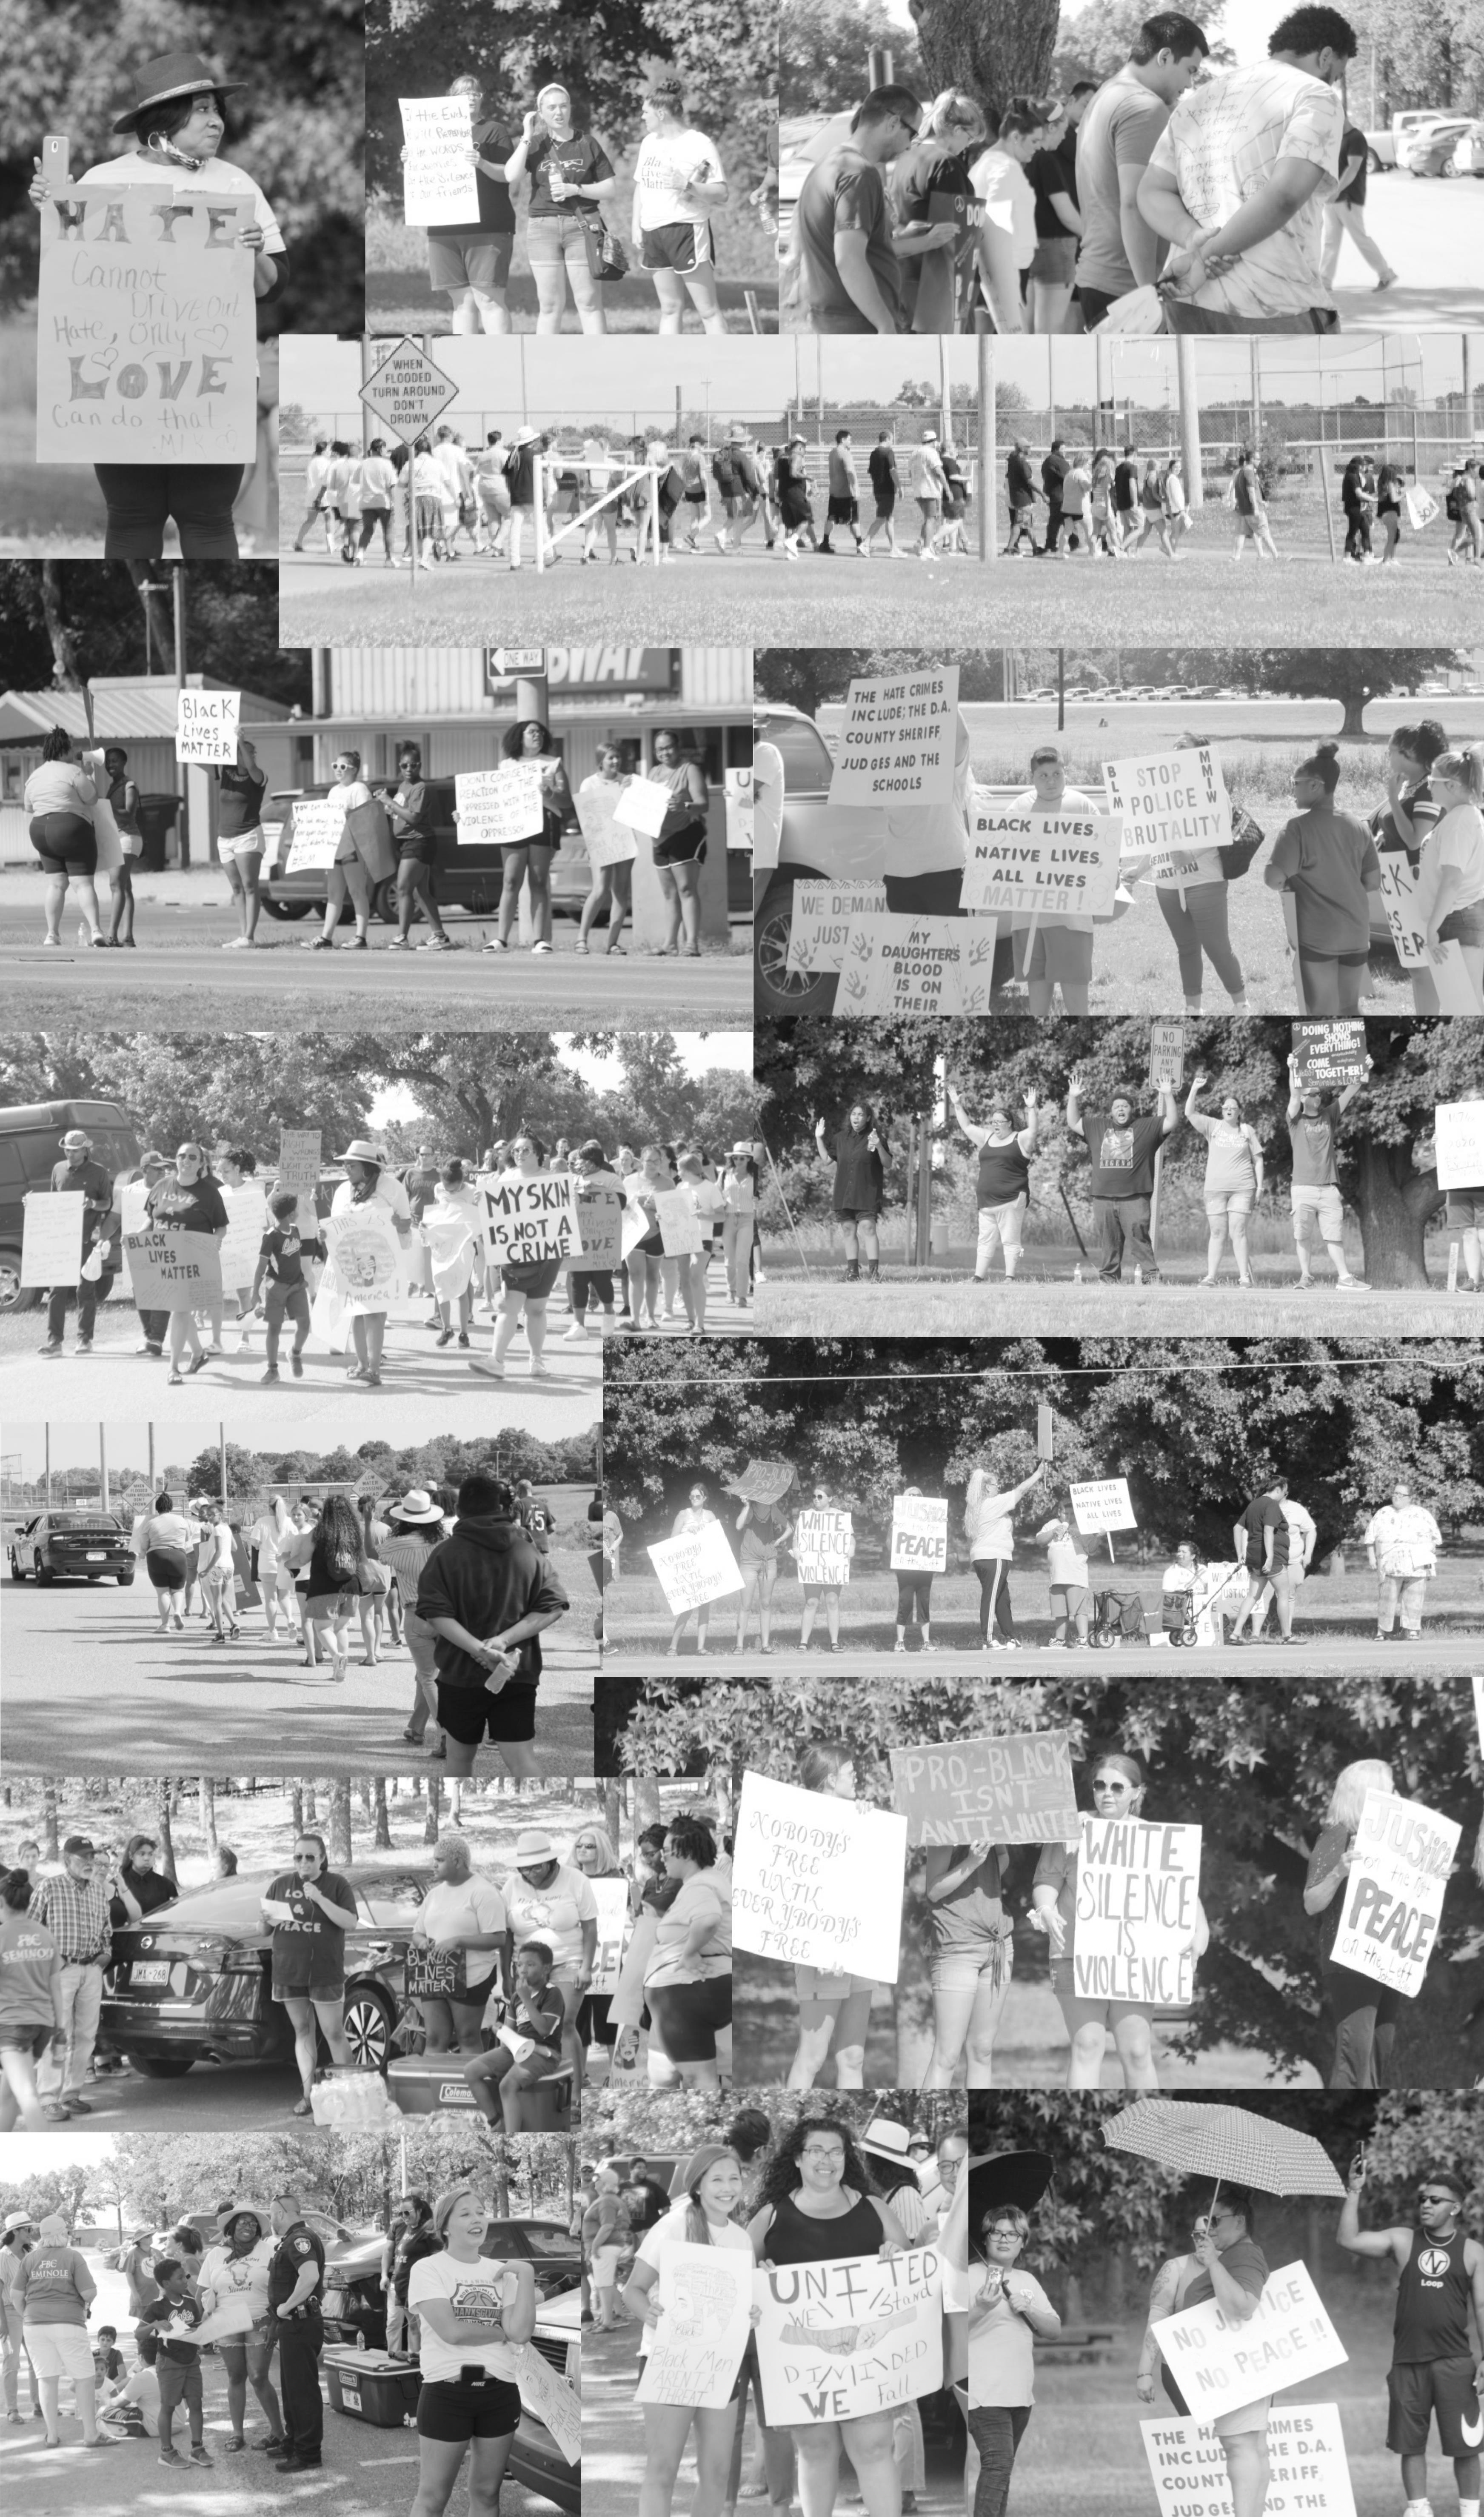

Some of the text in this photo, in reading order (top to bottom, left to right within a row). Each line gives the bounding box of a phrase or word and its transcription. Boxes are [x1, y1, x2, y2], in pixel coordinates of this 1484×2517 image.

[416, 109, 439, 122] the
[429, 143, 465, 155] WORDS
[53, 200, 237, 250] HATE
[72, 250, 167, 292] Cannot
[131, 291, 241, 322] Drive Out
[54, 315, 186, 362] Hate, Only
[393, 359, 422, 369] WHEN
[68, 353, 234, 402] LOVE
[385, 372, 431, 383] FLOODED
[372, 385, 445, 397] TURN AROUND
[393, 399, 423, 410] DON'T
[52, 404, 143, 428] Can do
[390, 414, 428, 424] DROWN
[504, 651, 539, 666] ONE WAY
[855, 681, 943, 703] THE HATE CRIMES
[851, 700, 951, 722] INCLUDE; THE D.A.
[846, 725, 942, 744] COUNTY SHERIFF,
[181, 741, 231, 758] MATTER
[842, 753, 939, 770] JUDGES AND THE
[490, 763, 537, 783] CONFUSE THE
[1136, 763, 1181, 787] STOP
[459, 776, 534, 800] REACTION OF THE
[872, 777, 922, 792] SCHOOLS
[503, 790, 537, 807] WITH THE
[1131, 788, 1197, 816] POLICE
[461, 802, 538, 826] VIOLENCE OF THE
[481, 825, 524, 838] OPPRESSOR
[977, 818, 1099, 841] BLACK LIVES,
[1124, 813, 1220, 847] BRUTALITY
[975, 846, 1103, 868] NATIVE LIVES,
[992, 869, 1086, 888] ALL LIVES
[802, 896, 824, 915] WE
[909, 931, 931, 944] MY
[893, 962, 942, 976] BLOOD
[896, 979, 942, 994] IS ON
[893, 996, 938, 1012] THEIR
[1163, 1032, 1174, 1043] NO
[1302, 1021, 1365, 1036] DOING NOTHING
[1324, 1032, 1350, 1043] SHOWS
[1154, 1045, 1181, 1058] PARKING
[1310, 1037, 1361, 1055] EVERYTHING!
[1161, 1058, 1173, 1067] ANY
[1307, 1058, 1330, 1069] COME
[1315, 1064, 1363, 1079] TOGETHER!
[1159, 1067, 1174, 1077] TIME
[1343, 1075, 1360, 1085] LOVE
[283, 1139, 305, 1149] RIGHT
[282, 1161, 301, 1170] LIGHT
[285, 1170, 317, 1181] TRUTH
[162, 1192, 195, 1204] LOVE
[484, 1179, 570, 1218] MY SKIN
[489, 1215, 572, 1245] IS NOT A
[128, 1235, 166, 1249] BLACK
[506, 1239, 571, 1263] CRIME
[148, 1250, 176, 1263] LIVES
[161, 1264, 200, 1279] MATTER
[1073, 1486, 1094, 1495] BLACK
[1076, 1500, 1101, 1508] NATIVE
[528, 1510, 545, 1531] 45
[802, 1512, 845, 1532] WHITE
[799, 1532, 849, 1554] SILENCE
[896, 1532, 945, 1558] PEACE
[674, 1558, 696, 1575] FREE
[818, 1552, 826, 1566] IS
[799, 1564, 848, 1584] VIOLENCE
[905, 1742, 1070, 1792] PRO-BLACK
[951, 1779, 1034, 1815] ISN'T
[750, 1811, 850, 1853] NOBODY'S
[920, 1810, 1079, 1845] ANTI-WHITE
[1084, 1821, 1186, 1871] WHITE
[772, 1844, 819, 1875] FREE
[1364, 1856, 1410, 1886] on the
[759, 1869, 823, 1912] UNTIL
[293, 1903, 304, 1915] &
[1077, 1872, 1195, 1930] SILENCE
[733, 1888, 862, 1943] EVERYBODY'S
[1348, 1877, 1436, 1963] PEACE
[279, 1922, 322, 1933] PEACE
[759, 1930, 810, 1961] FREE
[1117, 1921, 1136, 1957] IS
[1342, 1938, 1413, 1982] on the Left
[153, 1969, 166, 1980] 268
[415, 1965, 455, 1981] LIVES
[1075, 1954, 1191, 2003] VIOLENCE
[408, 1979, 455, 1995] MATTER!
[445, 2087, 473, 2098] Colema
[39, 2259, 57, 2269] FBC
[769, 2250, 939, 2304] UNITED
[1421, 2279, 1444, 2289] Loop
[789, 2285, 933, 2330] WE Stand
[1172, 2326, 1207, 2351] NO
[649, 2346, 733, 2373] Black Men
[704, 2373, 715, 2391] A
[1195, 2366, 1230, 2392] NO
[655, 2386, 708, 2406] THREAT
[799, 2389, 850, 2419] WE
[1152, 2430, 1186, 2447] THE
[1298, 2439, 1333, 2455] D.A.
[1294, 2494, 1327, 2508] THE
